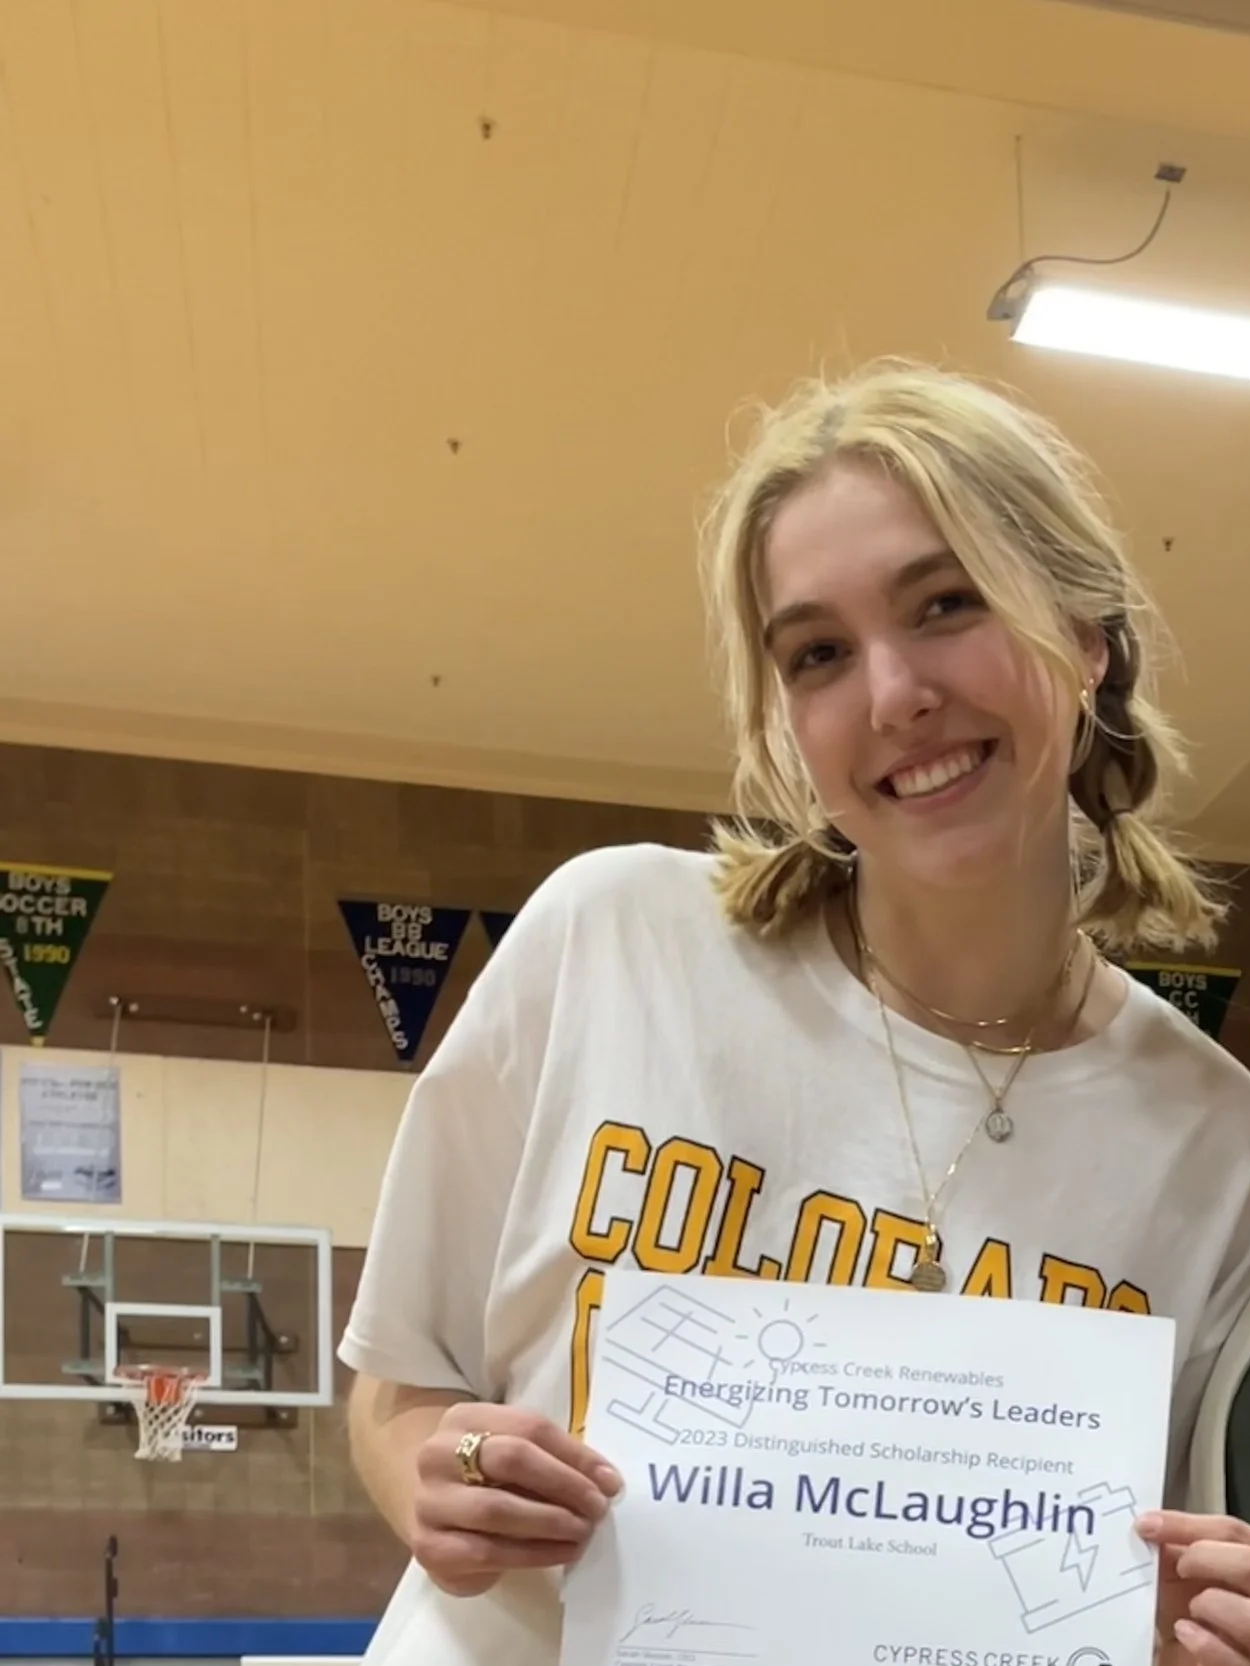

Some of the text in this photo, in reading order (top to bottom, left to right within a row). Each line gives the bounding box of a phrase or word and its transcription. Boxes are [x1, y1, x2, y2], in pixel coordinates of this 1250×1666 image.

[0, 893, 88, 918] OCCER
[377, 903, 433, 925] BOYS
[364, 936, 449, 961] LEAGUE
[1158, 971, 1207, 992] BOYS
[843, 1360, 893, 1380] Creek
[898, 1366, 1004, 1388] Renewables
[663, 1374, 810, 1412] Energizing
[992, 1399, 1101, 1430] Leaders
[181, 1429, 235, 1443] sitors
[680, 1429, 1074, 1475] 2023 Distinguished Scholarship Recipient
[647, 1462, 1096, 1541] Willa McLaughlin
[802, 1532, 938, 1557] Trout Lake School
